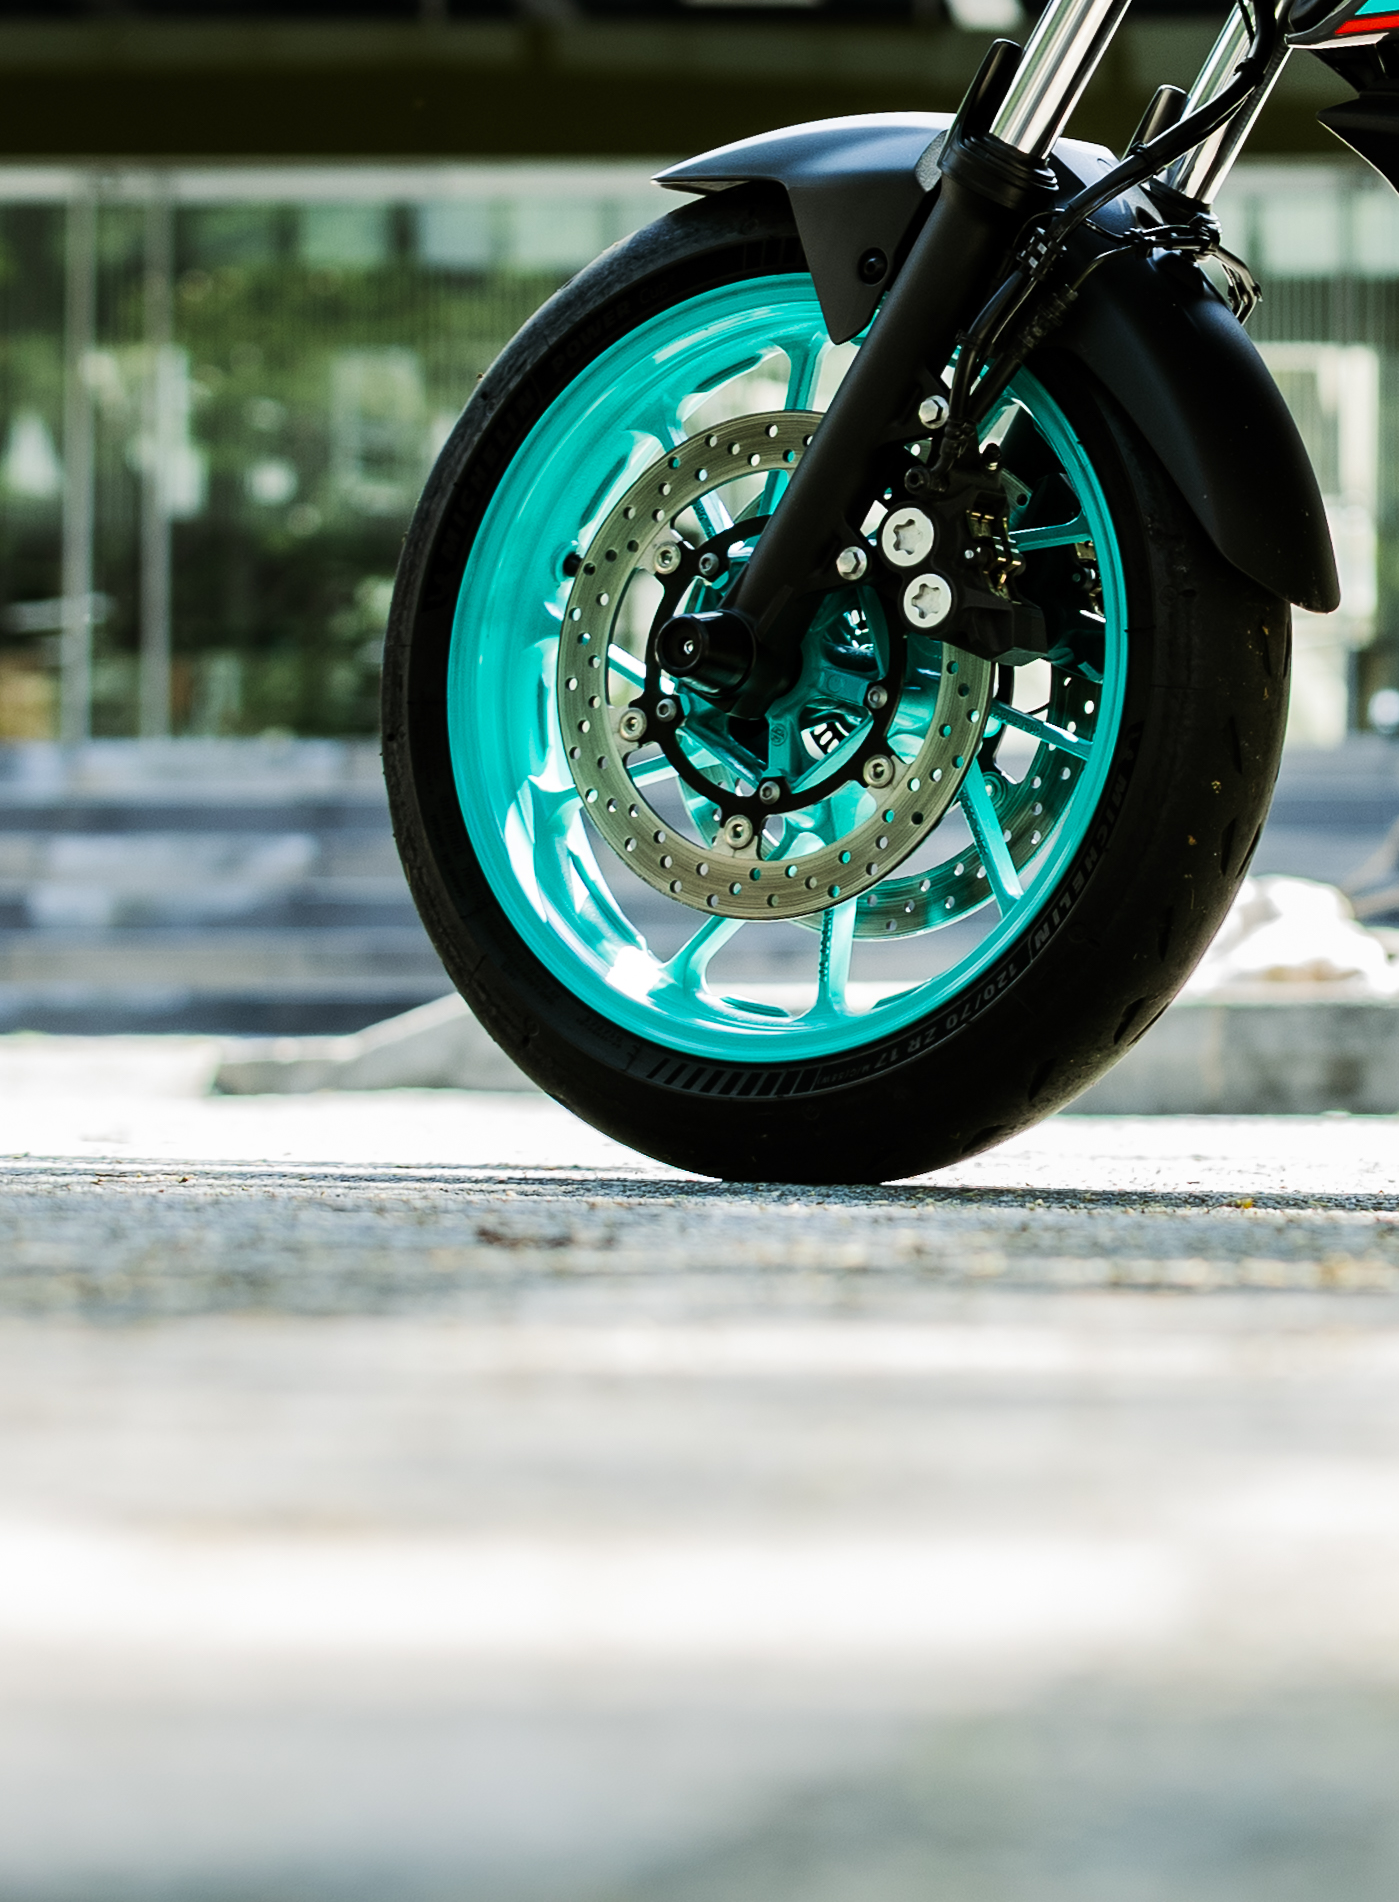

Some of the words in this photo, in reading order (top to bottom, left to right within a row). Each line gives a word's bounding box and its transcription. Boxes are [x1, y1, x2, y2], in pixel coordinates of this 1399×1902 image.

[1026, 772, 1130, 953] MICHELIN
[941, 961, 1019, 1031] 120/70
[871, 1046, 900, 1069] 17
[904, 1024, 941, 1053] ZR
